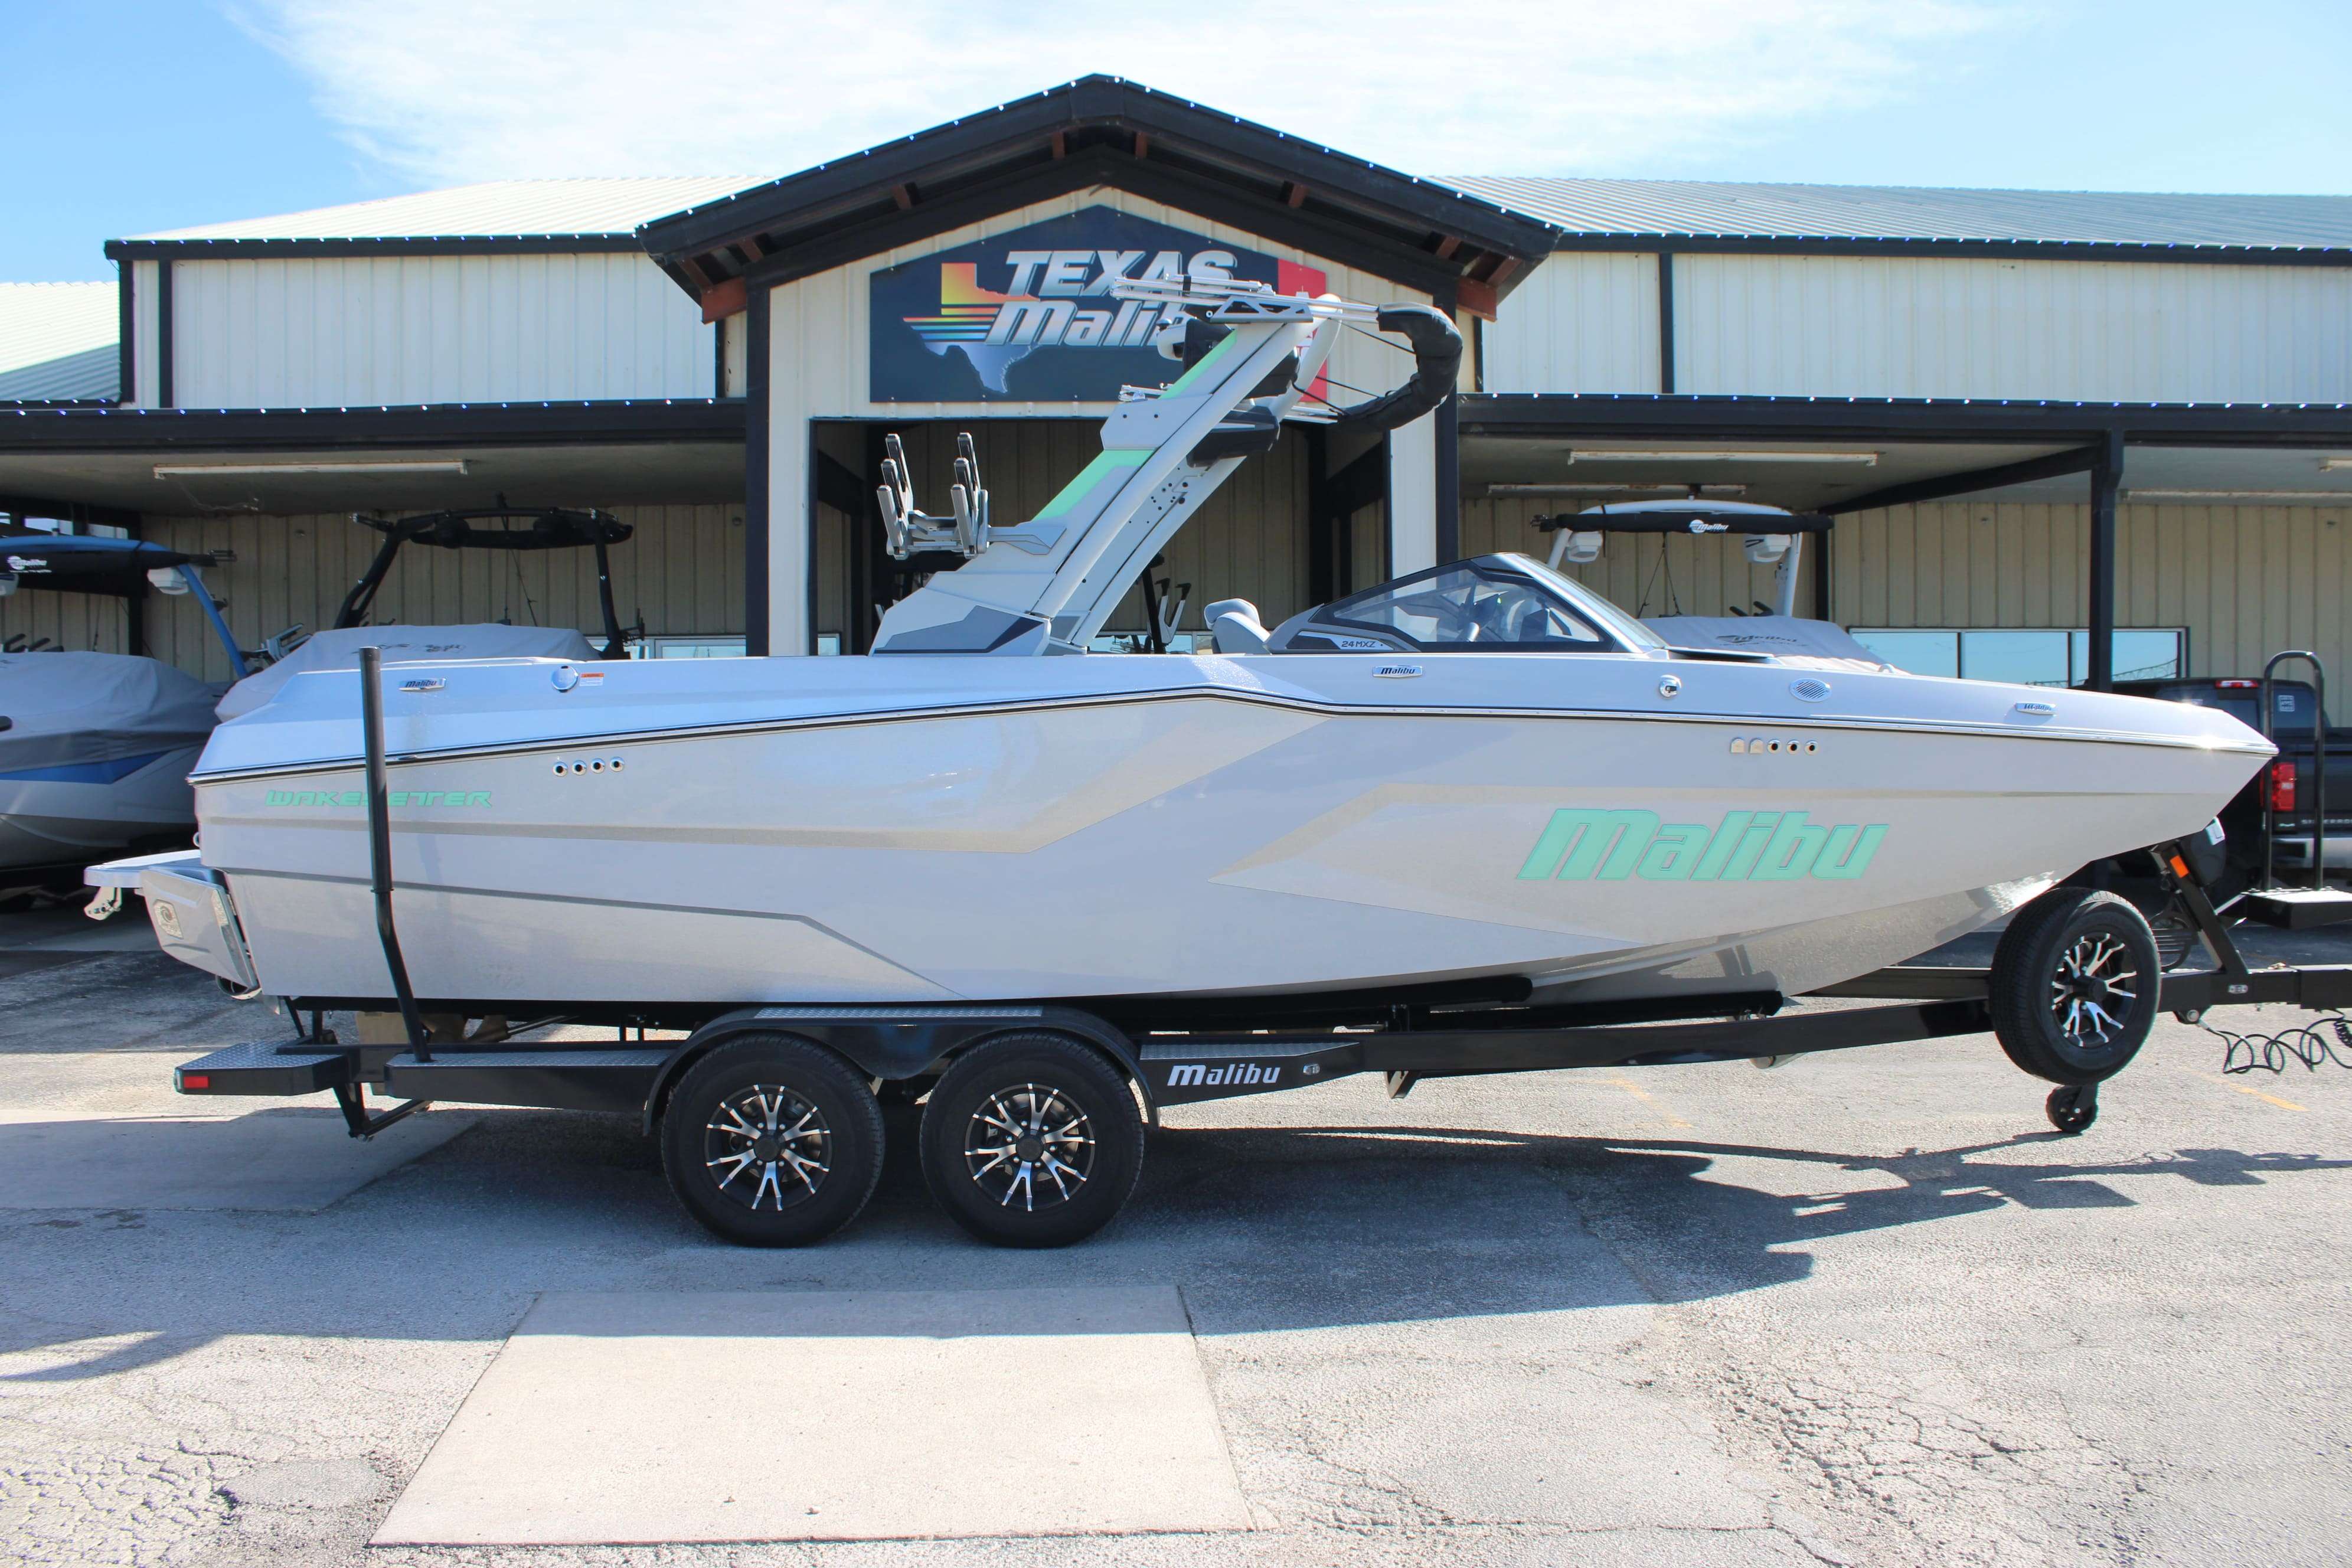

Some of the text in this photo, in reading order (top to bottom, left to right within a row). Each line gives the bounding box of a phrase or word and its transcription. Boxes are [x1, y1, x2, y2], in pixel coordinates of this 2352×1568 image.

[264, 789, 492, 808] WAKEETTER
[1515, 808, 1890, 881] Malibu
[1167, 1063, 1281, 1086] Malibu
